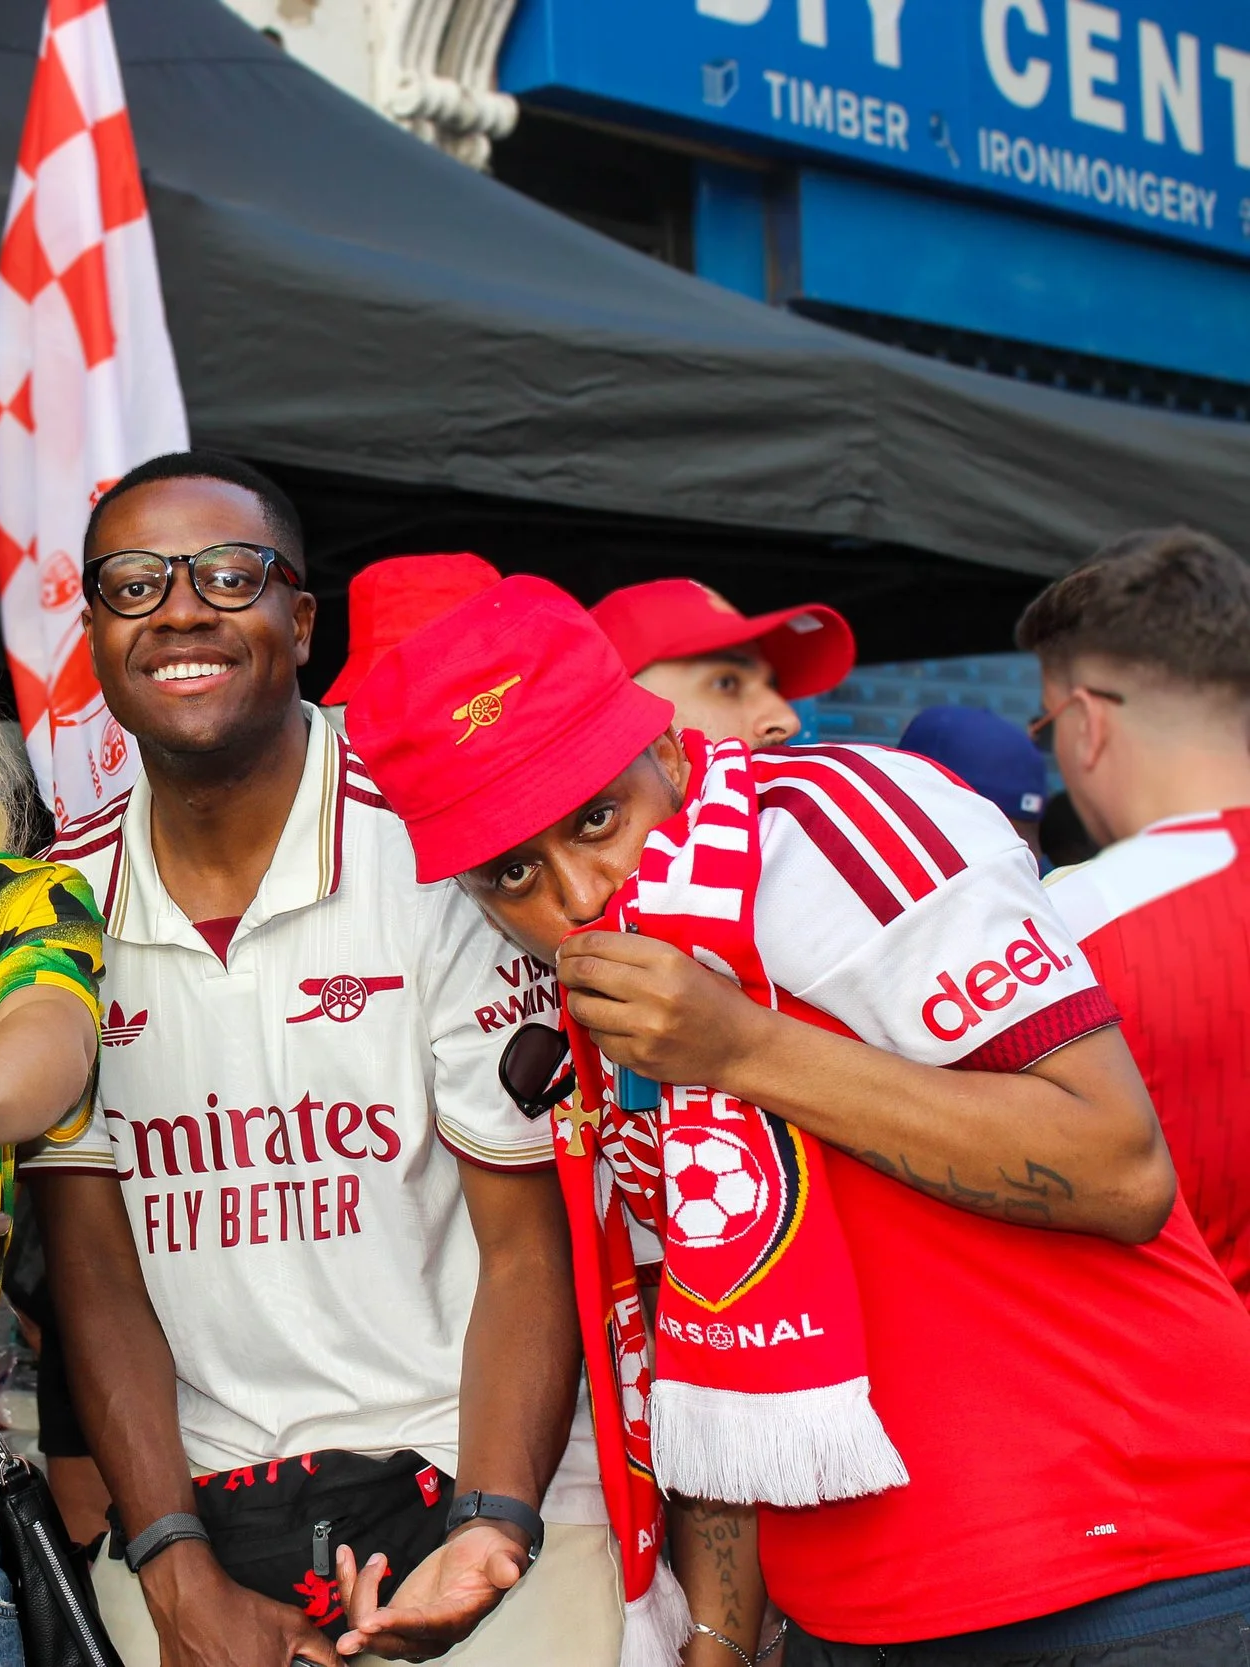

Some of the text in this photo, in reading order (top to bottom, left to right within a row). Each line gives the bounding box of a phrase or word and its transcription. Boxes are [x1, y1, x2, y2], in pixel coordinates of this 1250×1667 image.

[763, 69, 1217, 230] TIMBER IRONMONGERY
[921, 918, 1072, 1042] deel.
[144, 1174, 361, 1254] FLY BETTER
[1093, 1523, 1118, 1536] COOL
